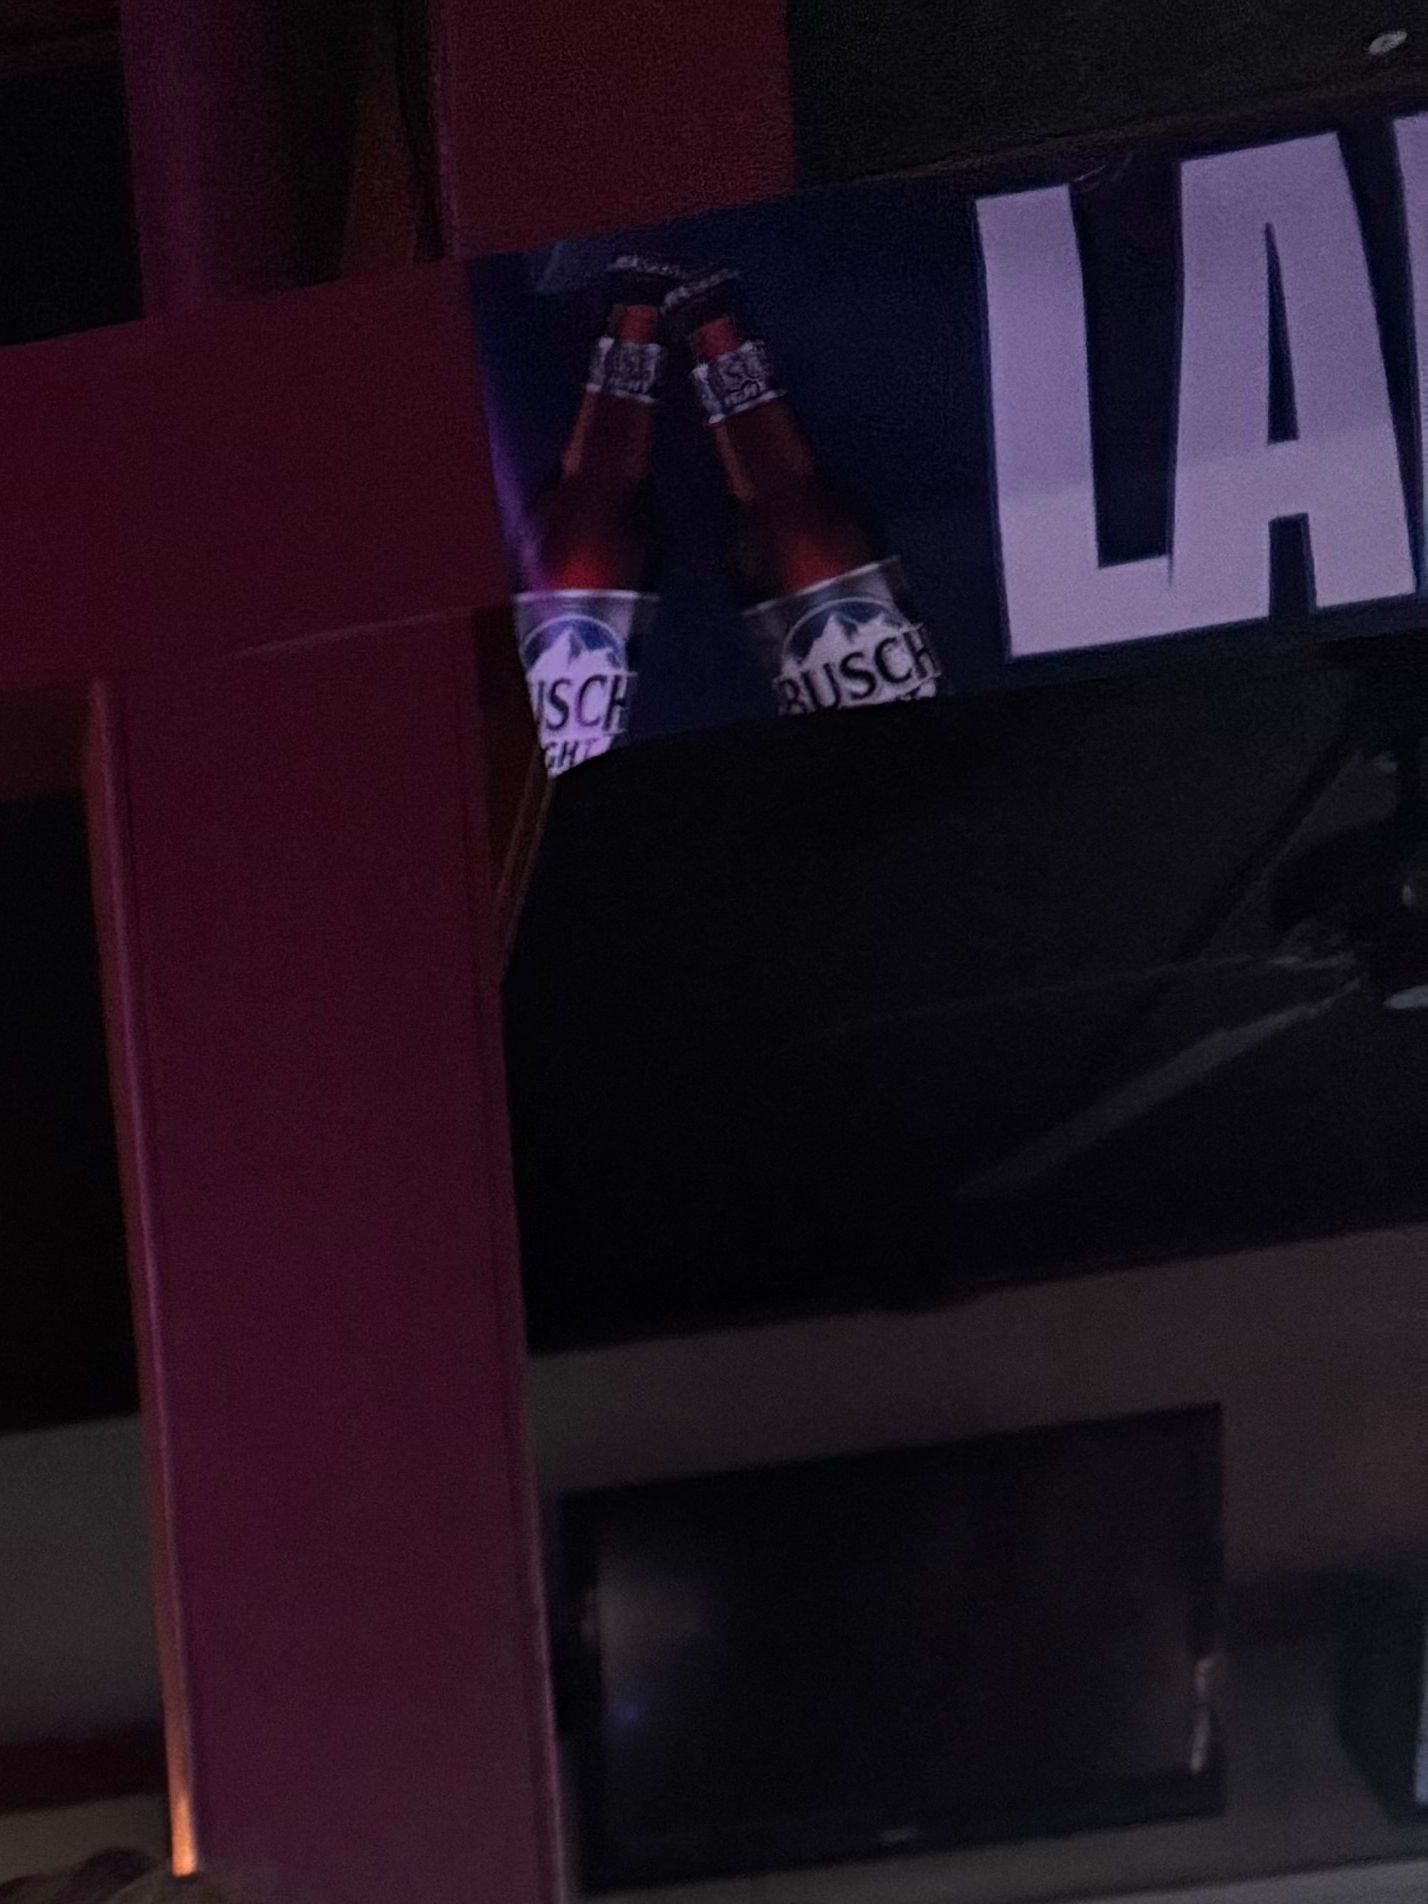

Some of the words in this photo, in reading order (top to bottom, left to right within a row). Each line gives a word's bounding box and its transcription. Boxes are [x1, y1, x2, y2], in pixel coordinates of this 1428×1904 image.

[976, 110, 1428, 659] LA
[537, 673, 627, 731] SCH
[543, 737, 599, 769] GHT
